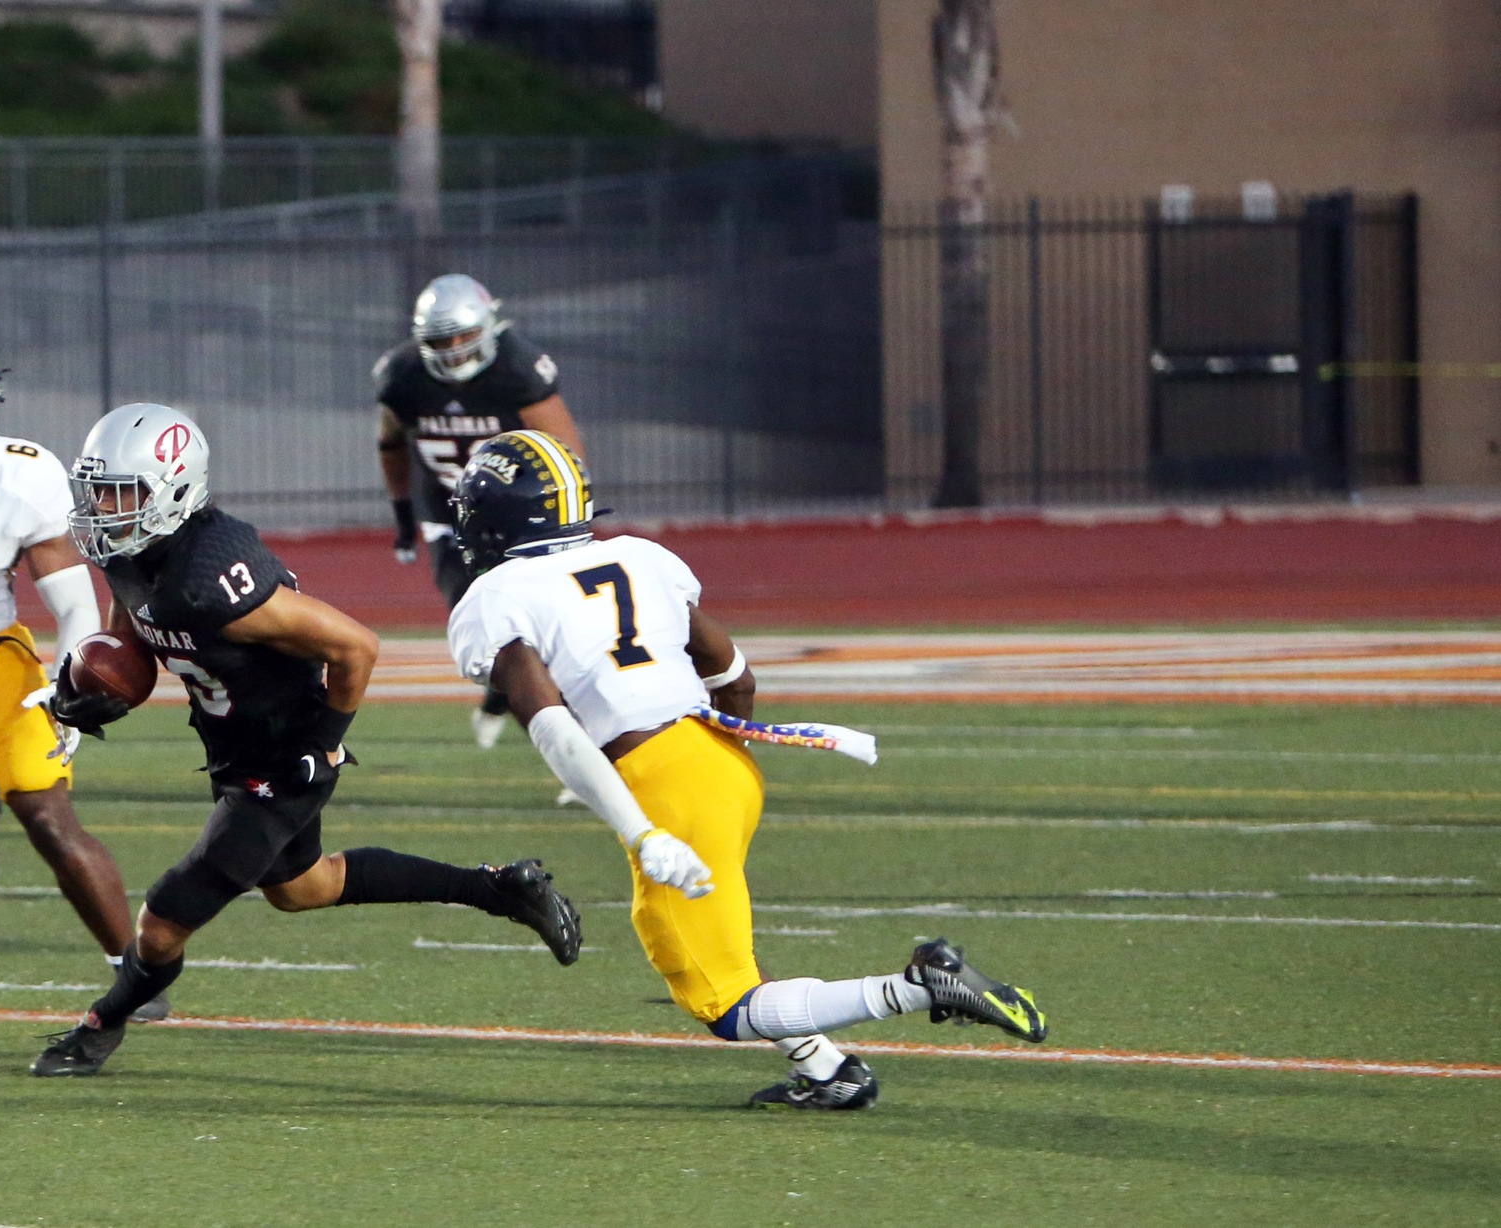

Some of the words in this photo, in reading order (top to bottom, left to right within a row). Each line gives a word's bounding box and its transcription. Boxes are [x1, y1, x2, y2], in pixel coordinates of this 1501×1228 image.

[418, 415, 501, 437] PALOMAR
[7, 444, 49, 459] 6
[218, 561, 256, 605] 13
[567, 561, 657, 672] 7
